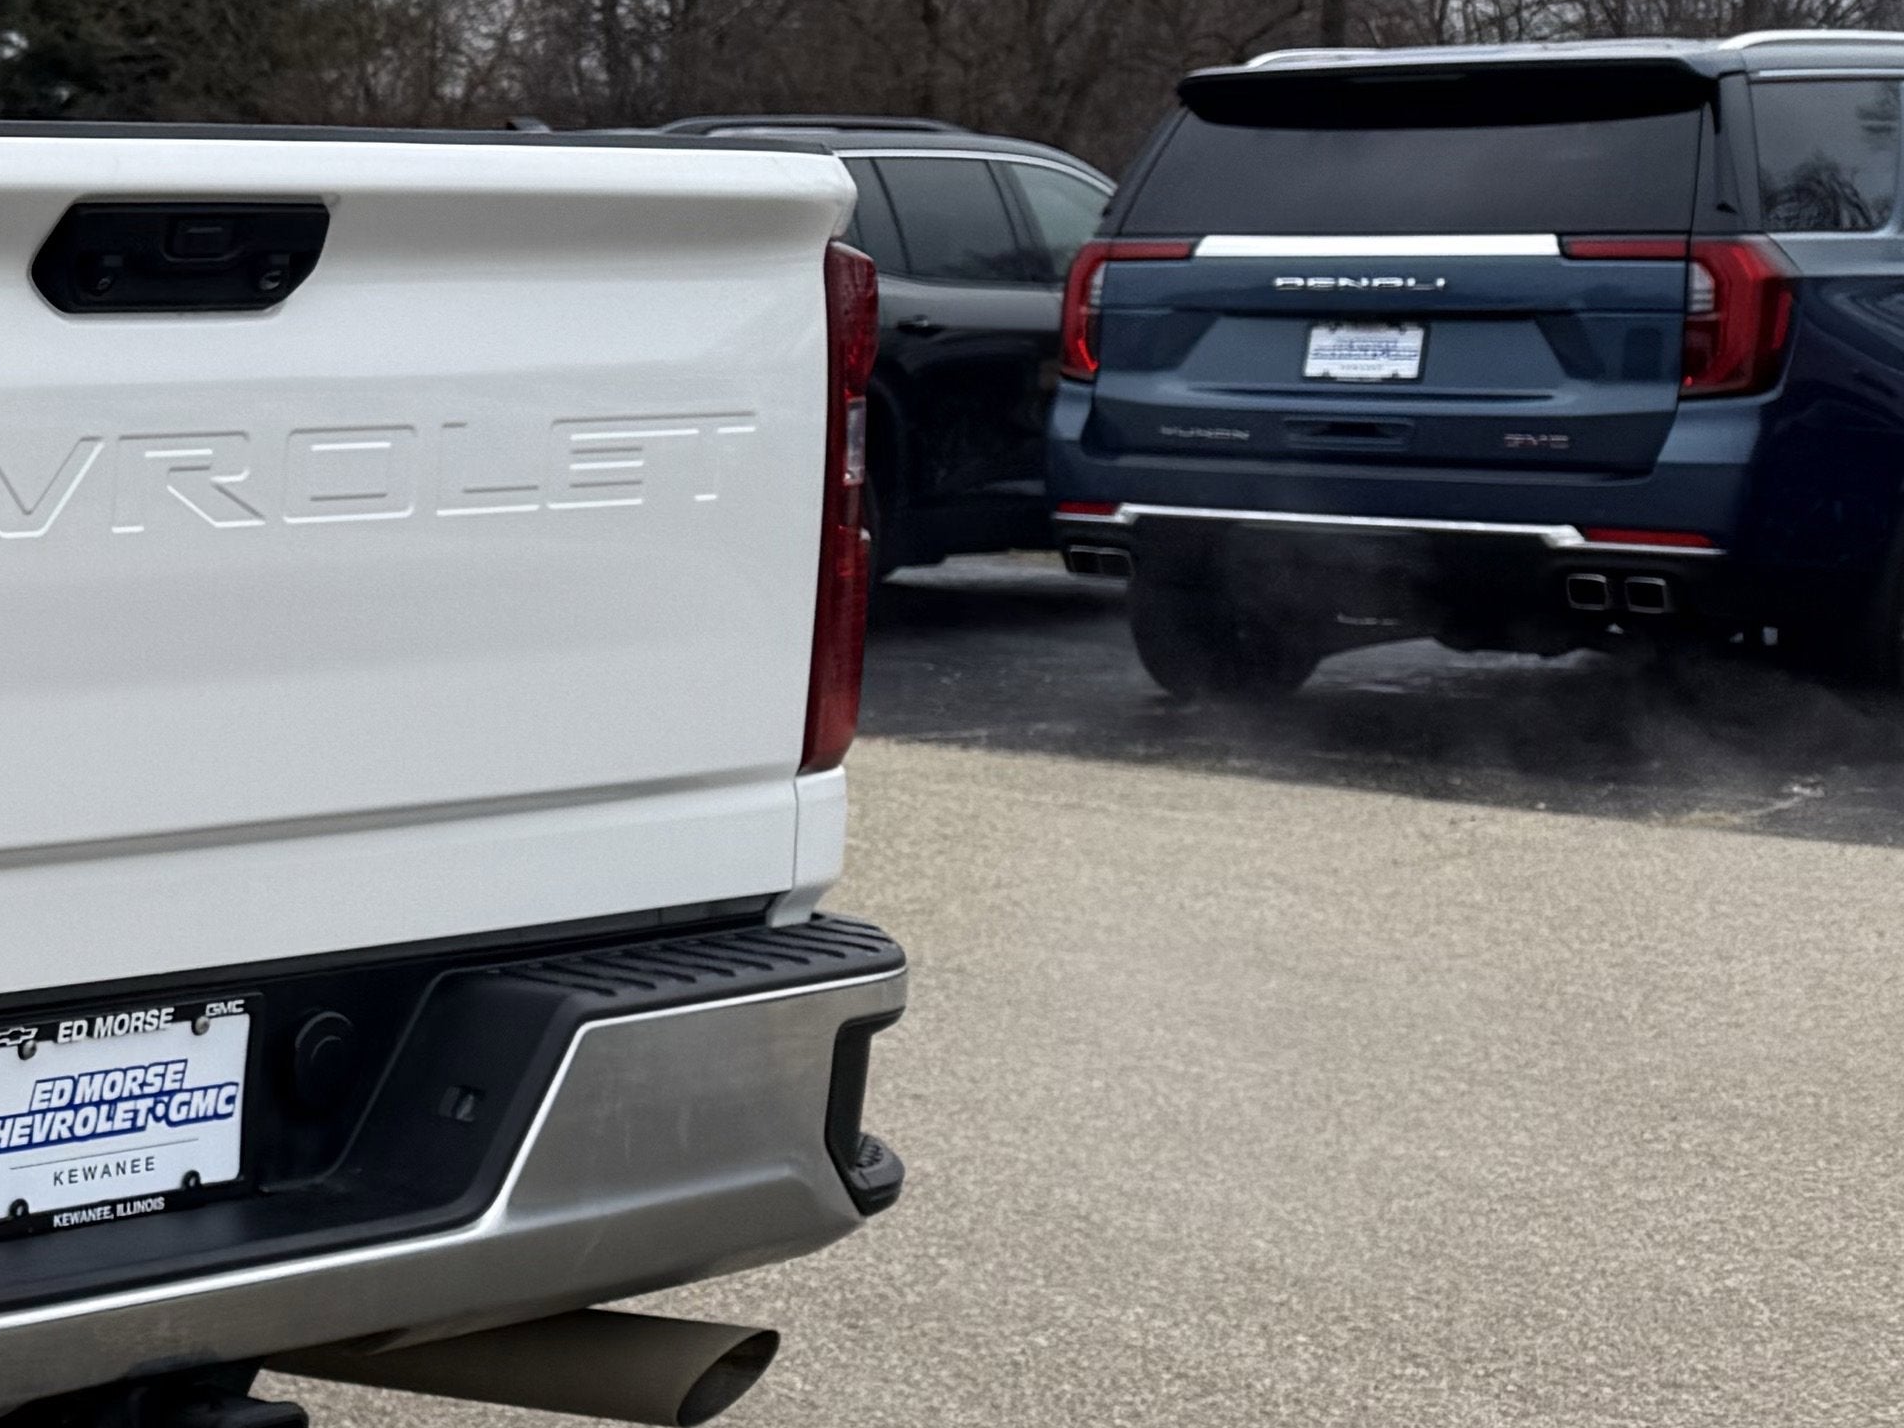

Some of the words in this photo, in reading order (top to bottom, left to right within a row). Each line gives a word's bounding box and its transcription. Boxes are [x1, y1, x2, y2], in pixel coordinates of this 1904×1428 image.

[1273, 276, 1447, 291] DENALI
[205, 999, 246, 1017] GMC
[56, 1019, 88, 1044] ED
[92, 1007, 175, 1040] MORSE
[30, 1074, 78, 1111] ED
[73, 1059, 188, 1104] MORSE
[52, 1155, 157, 1187] KEWANEE
[52, 1206, 115, 1228] KEWANEE,
[115, 1196, 166, 1218] ILLINOIS
